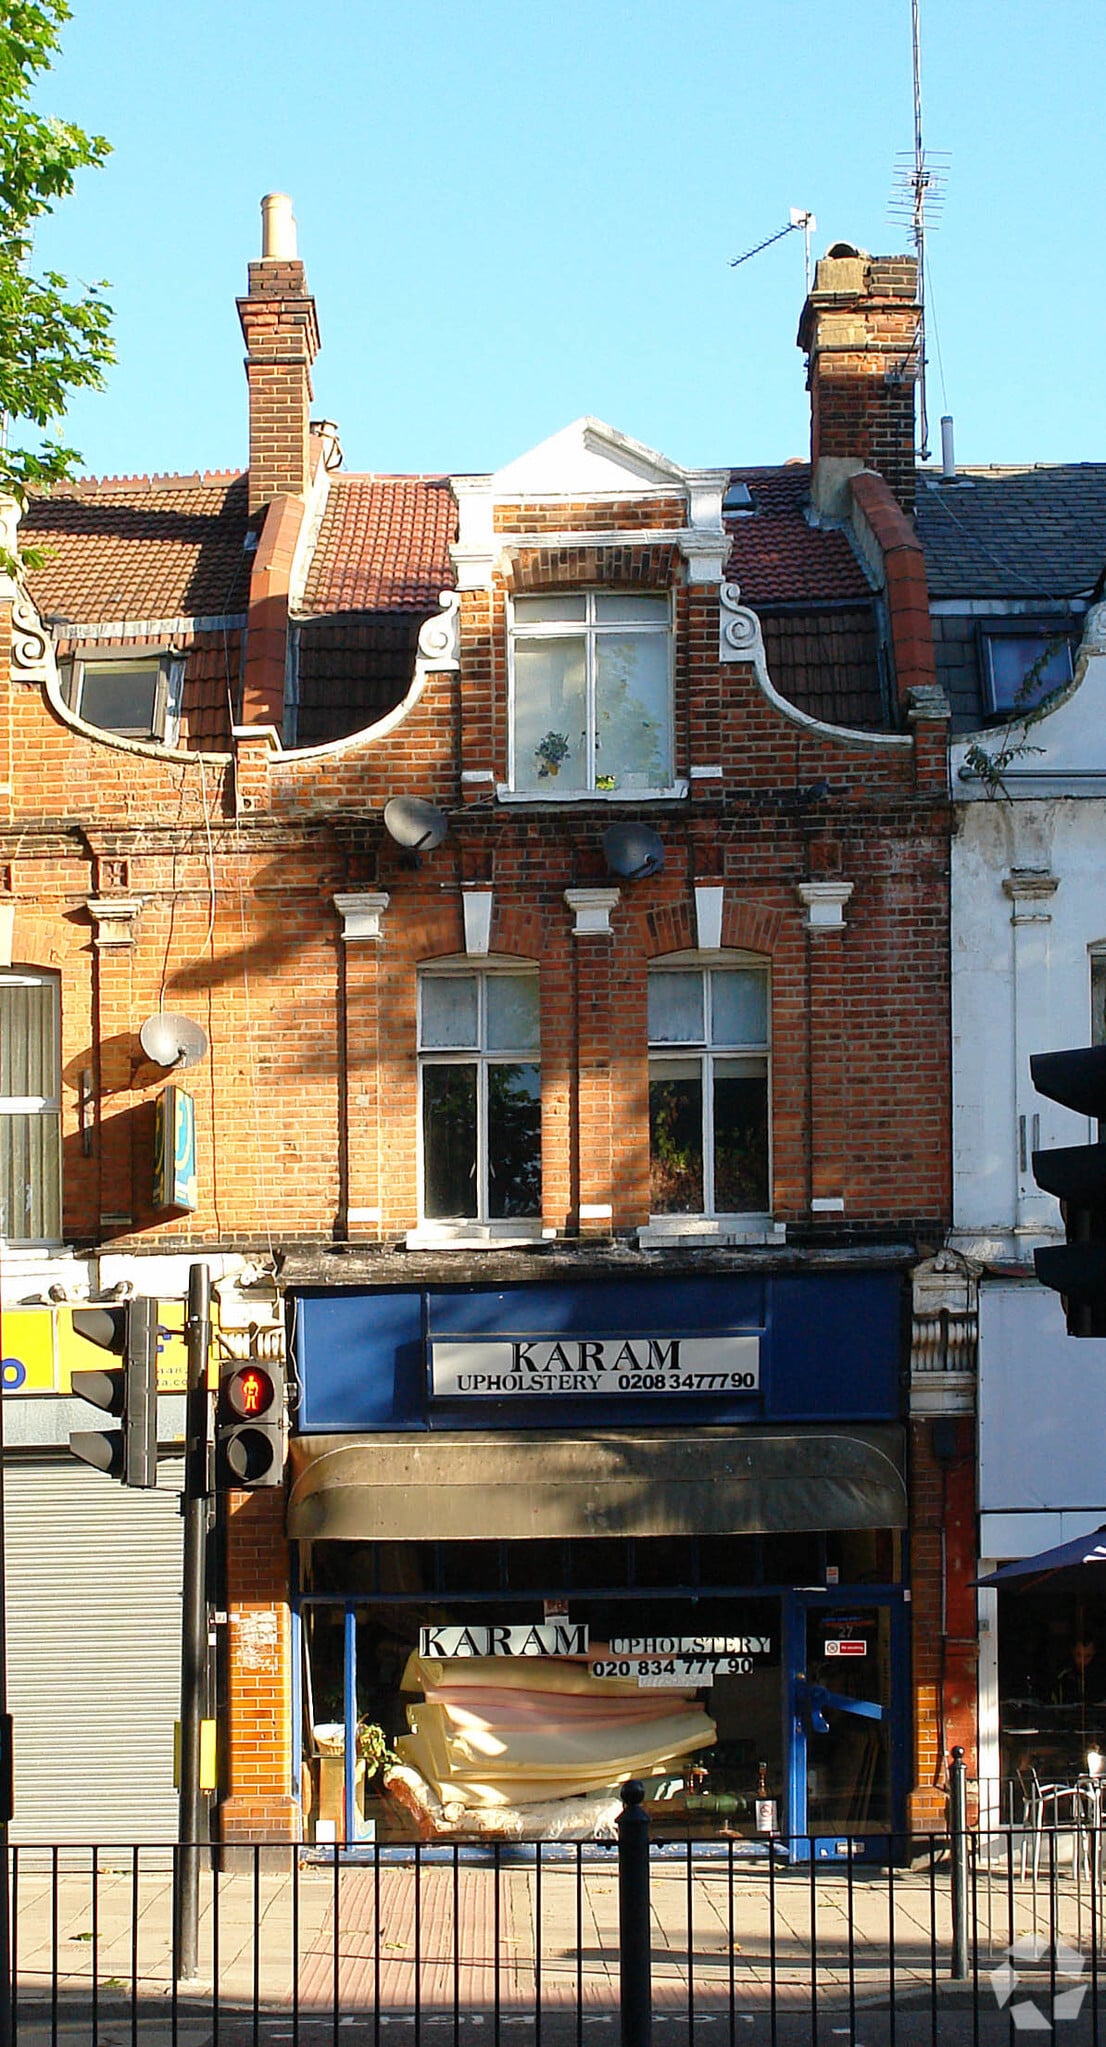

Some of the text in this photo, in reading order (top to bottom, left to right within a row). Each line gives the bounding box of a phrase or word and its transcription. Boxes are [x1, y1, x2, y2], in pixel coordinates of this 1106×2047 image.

[510, 1340, 682, 1373] KARAM
[456, 1374, 602, 1391] UPHOLSTERY
[421, 1625, 588, 1657] KARAM
[611, 1637, 769, 1655] UPHOLSTERY
[592, 1658, 752, 1677] 020 834 777 90
